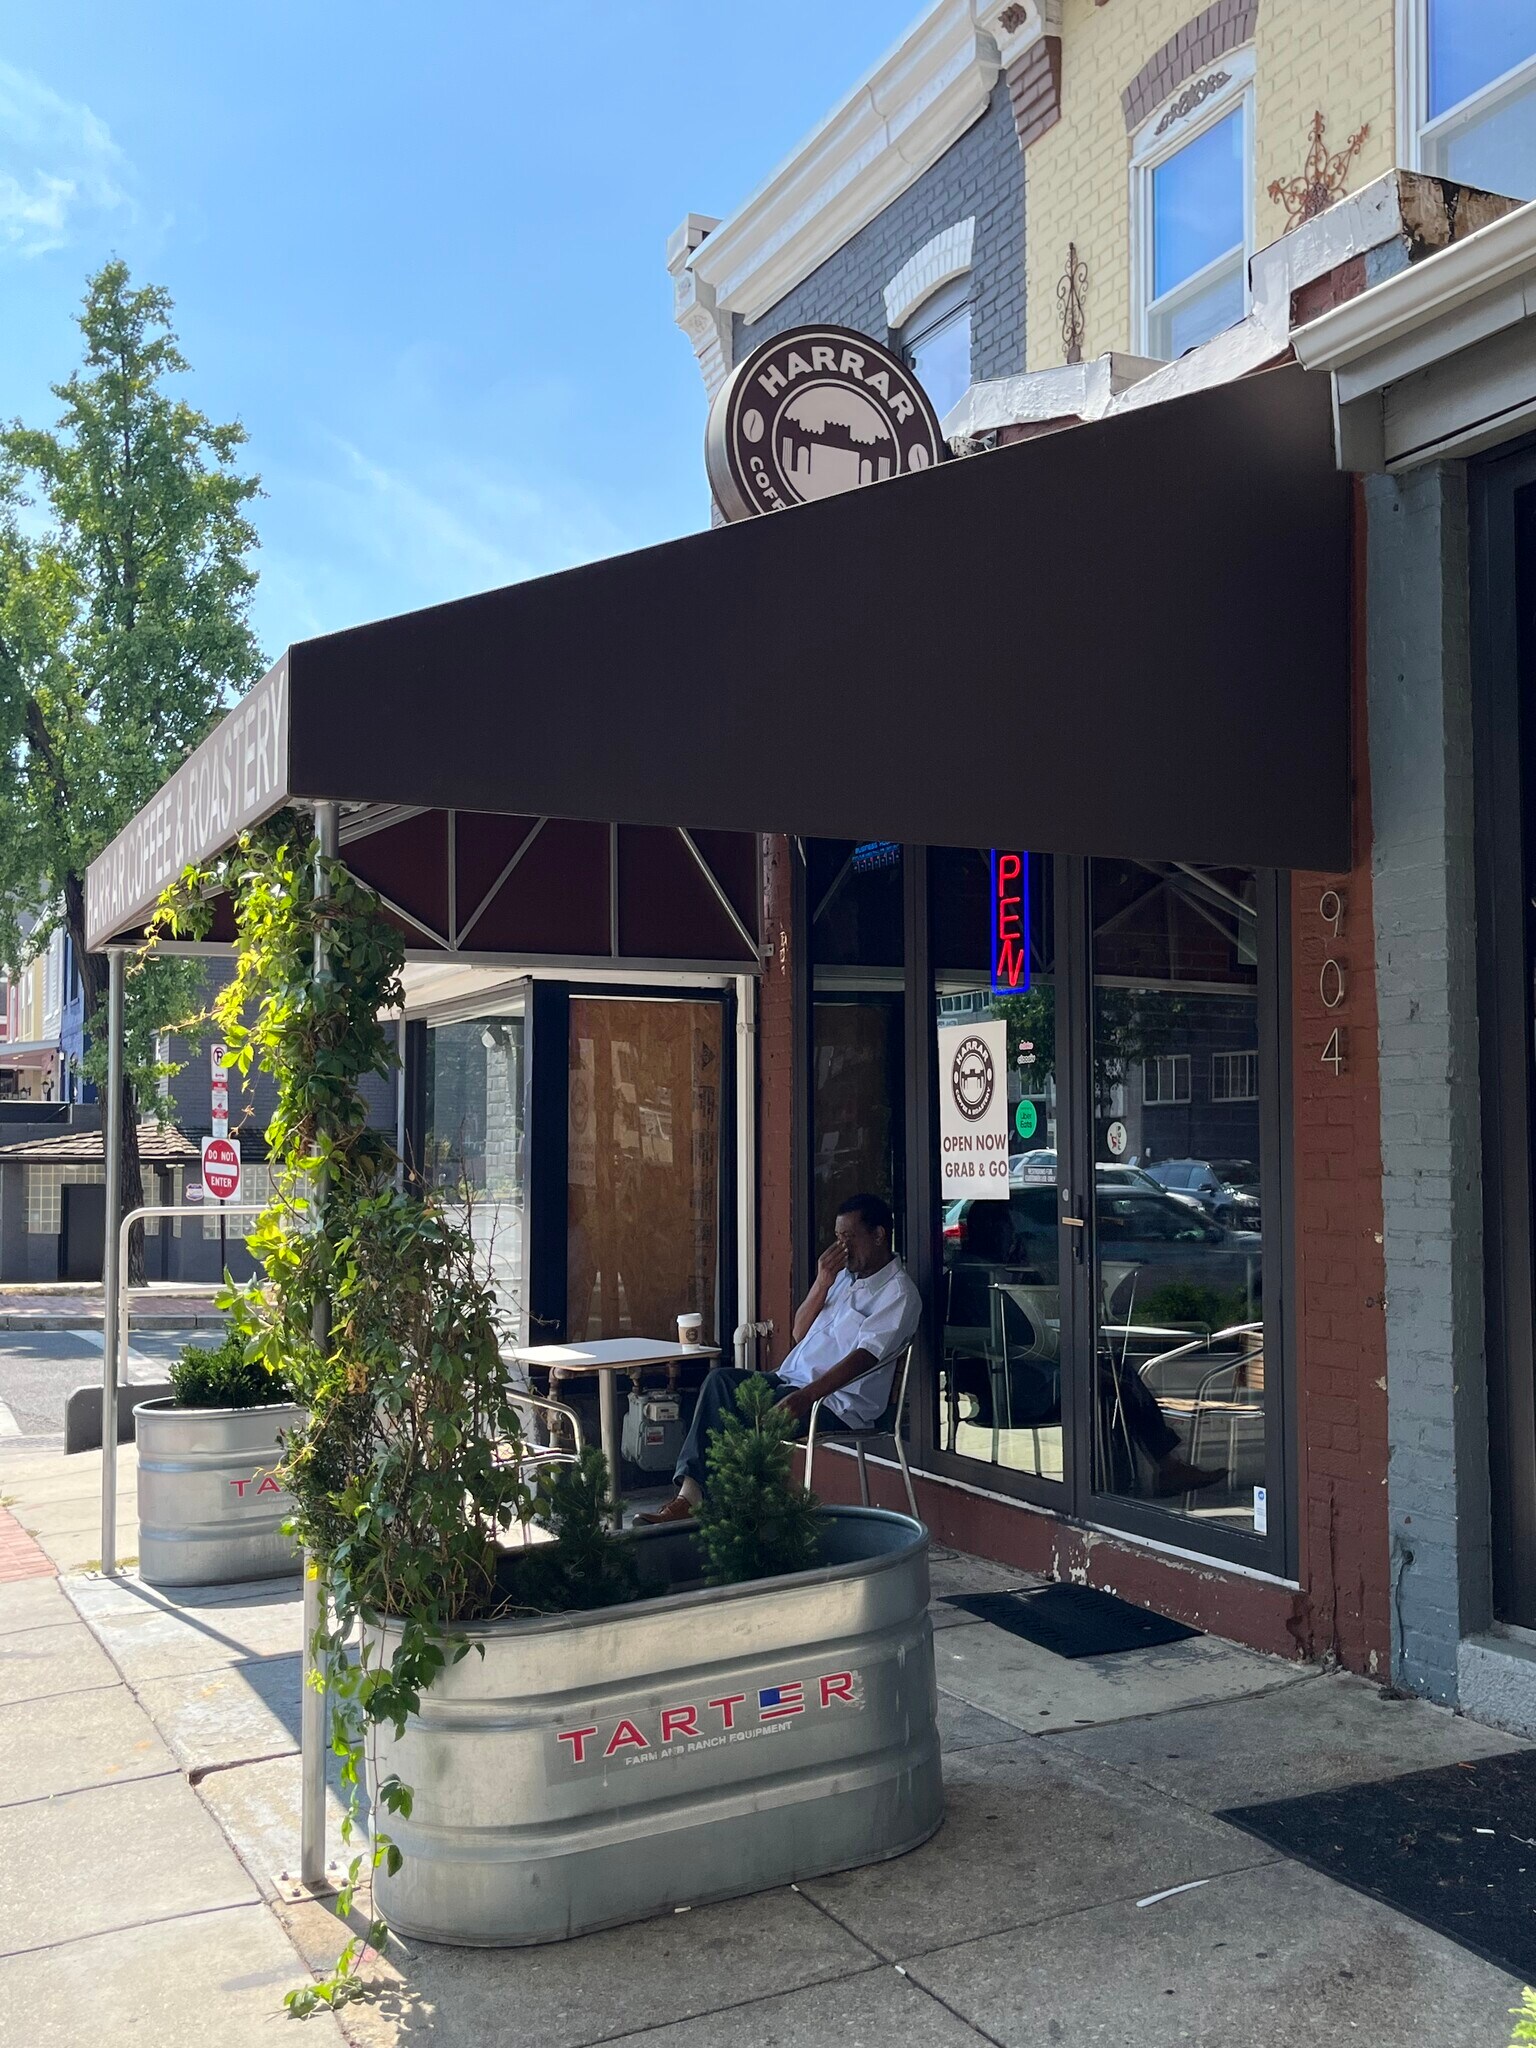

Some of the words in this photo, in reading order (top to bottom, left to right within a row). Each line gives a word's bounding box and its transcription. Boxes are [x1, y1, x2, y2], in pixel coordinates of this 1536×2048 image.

[757, 346, 915, 424] HARRAR
[87, 840, 125, 939] HARRAR
[127, 791, 173, 906] COFFEE
[175, 780, 184, 869] &
[188, 670, 285, 853] ROASTERY
[956, 1041, 989, 1065] HARRAR
[1020, 1112, 1032, 1120] Uber
[1020, 1120, 1033, 1129] Eats
[943, 1135, 973, 1153] OPEN
[976, 1133, 1007, 1151] NOW
[208, 1149, 218, 1160] DO
[221, 1151, 235, 1163] NOT
[945, 1161, 975, 1178] GRAB
[979, 1163, 985, 1177] &
[989, 1160, 1008, 1178] GO
[210, 1176, 233, 1188] ENTER
[557, 1670, 860, 1764] TARTER
[625, 1751, 658, 1766] FARM
[687, 1736, 727, 1753] RANCH
[728, 1720, 793, 1743] EQUIPMENT
